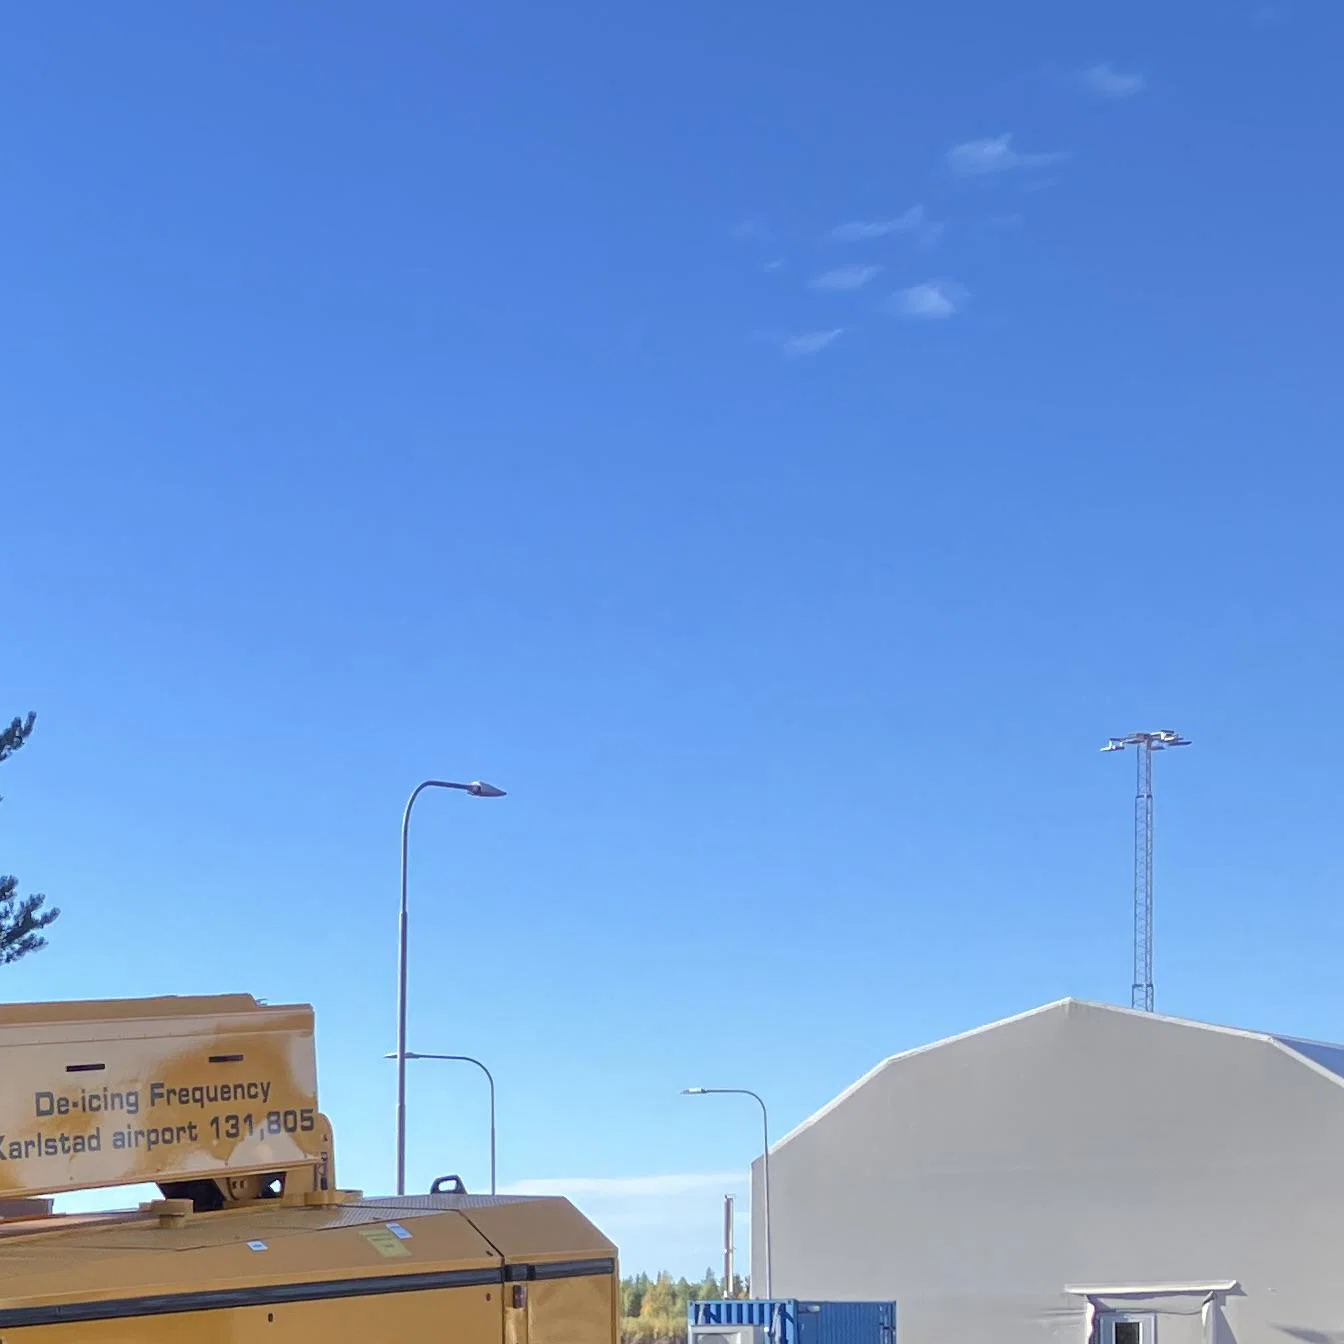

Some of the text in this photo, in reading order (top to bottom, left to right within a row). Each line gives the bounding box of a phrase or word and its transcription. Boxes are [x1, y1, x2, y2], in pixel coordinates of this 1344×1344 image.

[34, 1081, 271, 1117] De-icing Frequency
[112, 1121, 198, 1151] airport
[210, 1108, 315, 1142] 131,805
